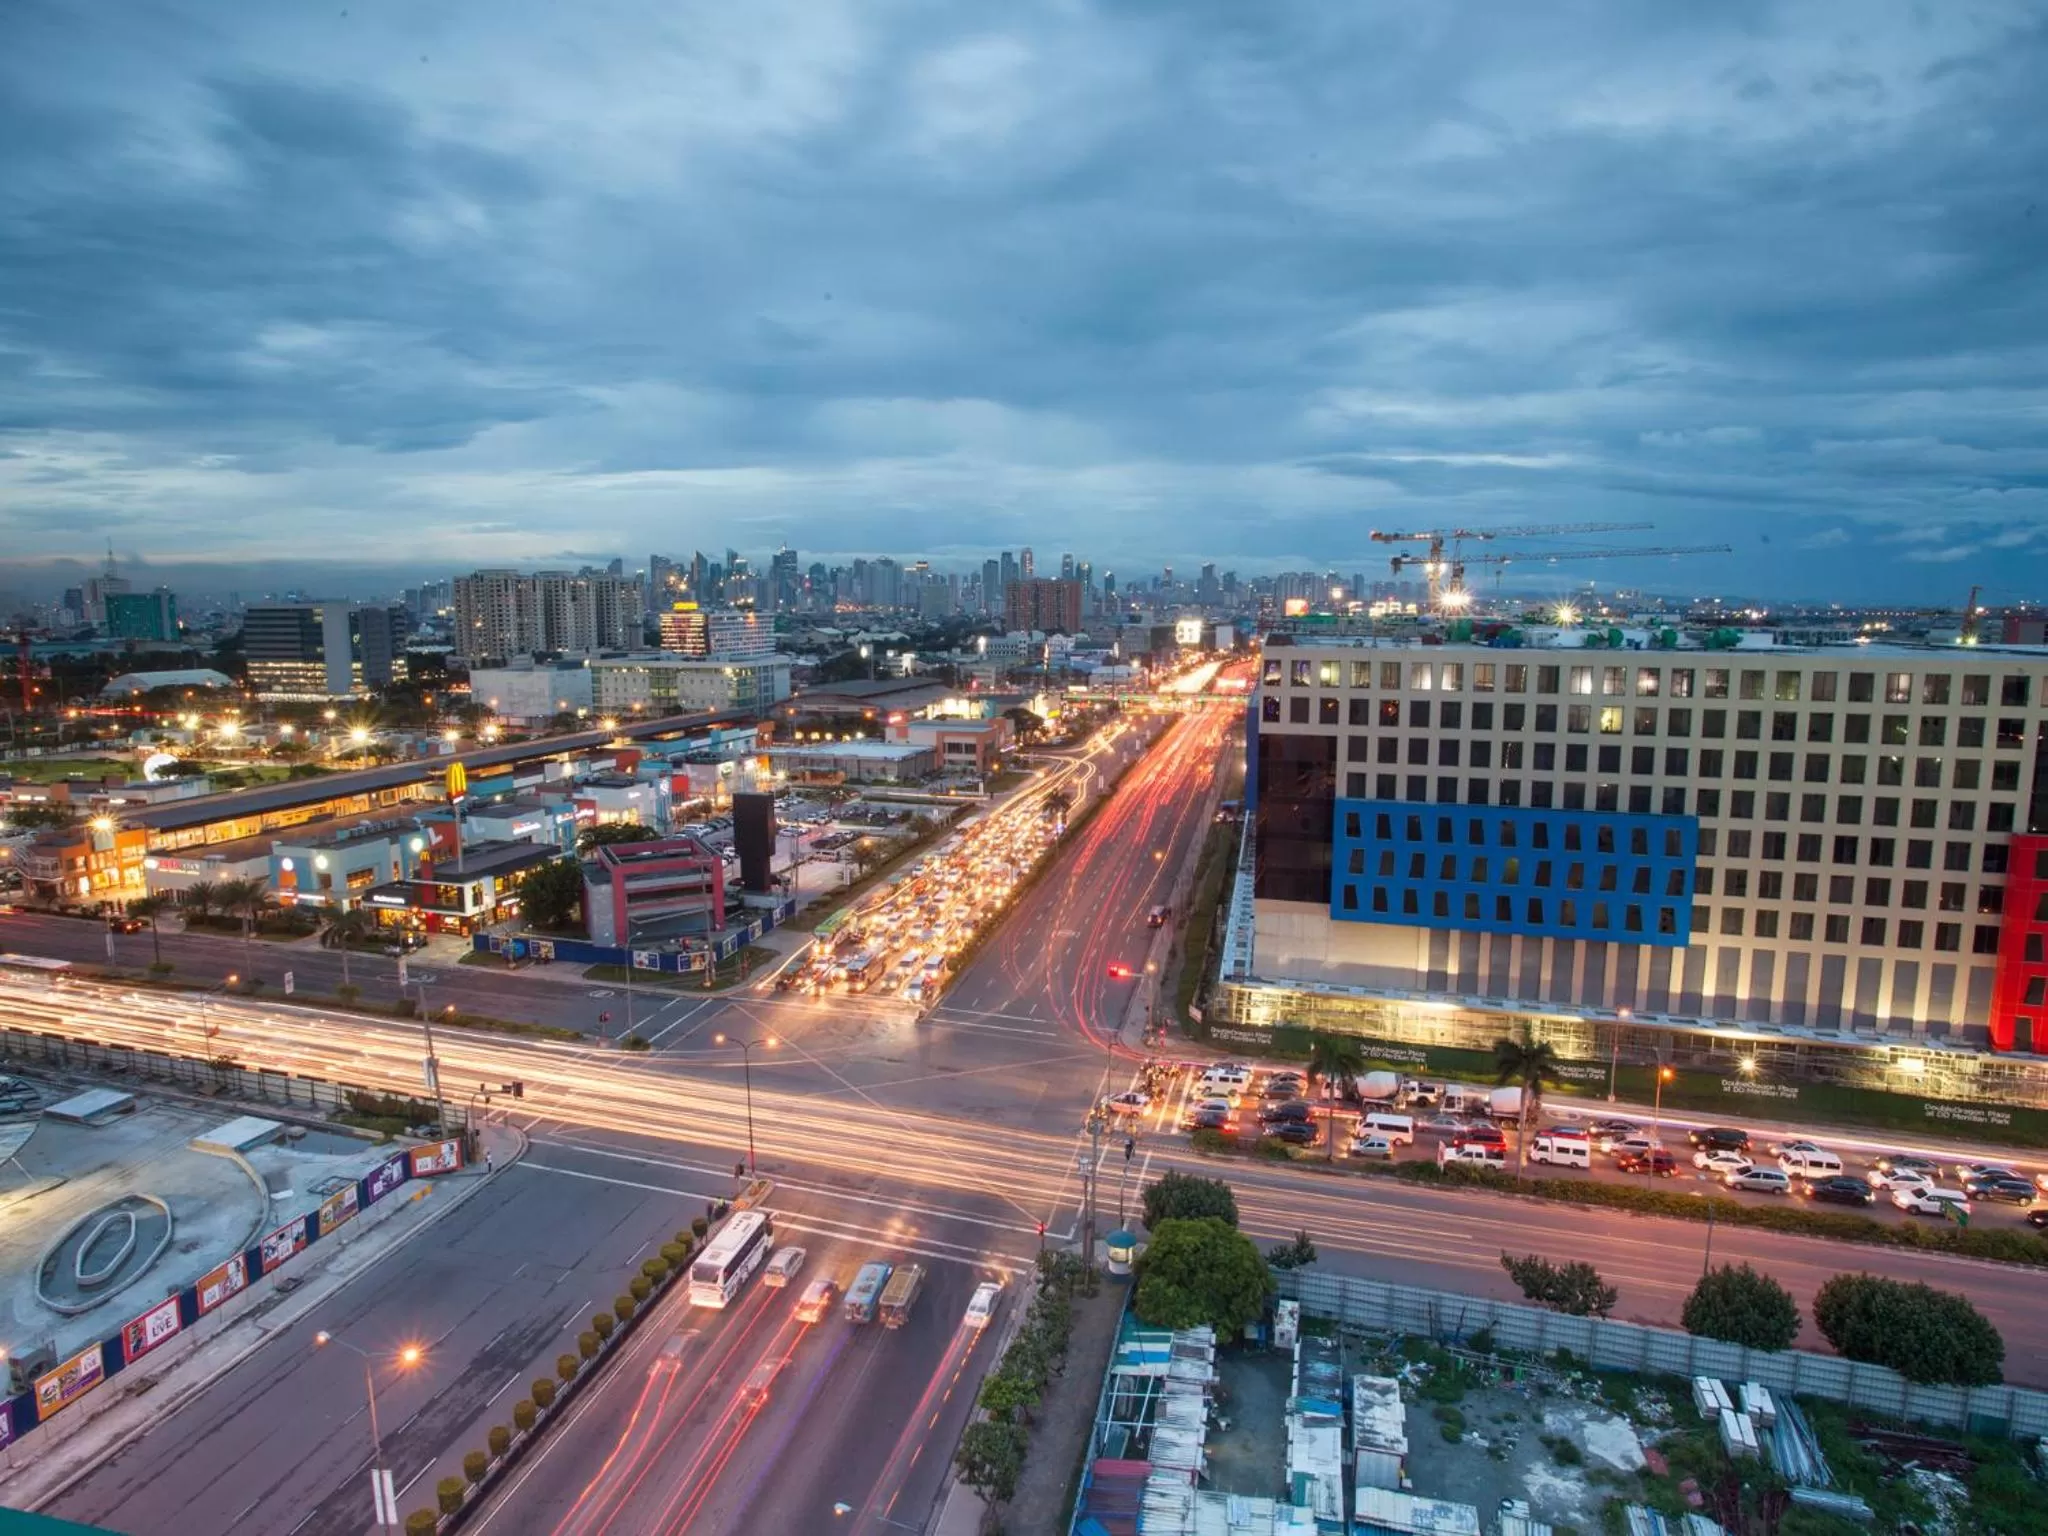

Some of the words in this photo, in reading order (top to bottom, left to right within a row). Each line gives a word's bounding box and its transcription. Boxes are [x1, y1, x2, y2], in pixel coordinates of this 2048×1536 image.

[1721, 1079, 1777, 1090] DoubleDragon
[1924, 1103, 1985, 1116] DoubleDragon
[152, 1315, 173, 1337] LIVE
